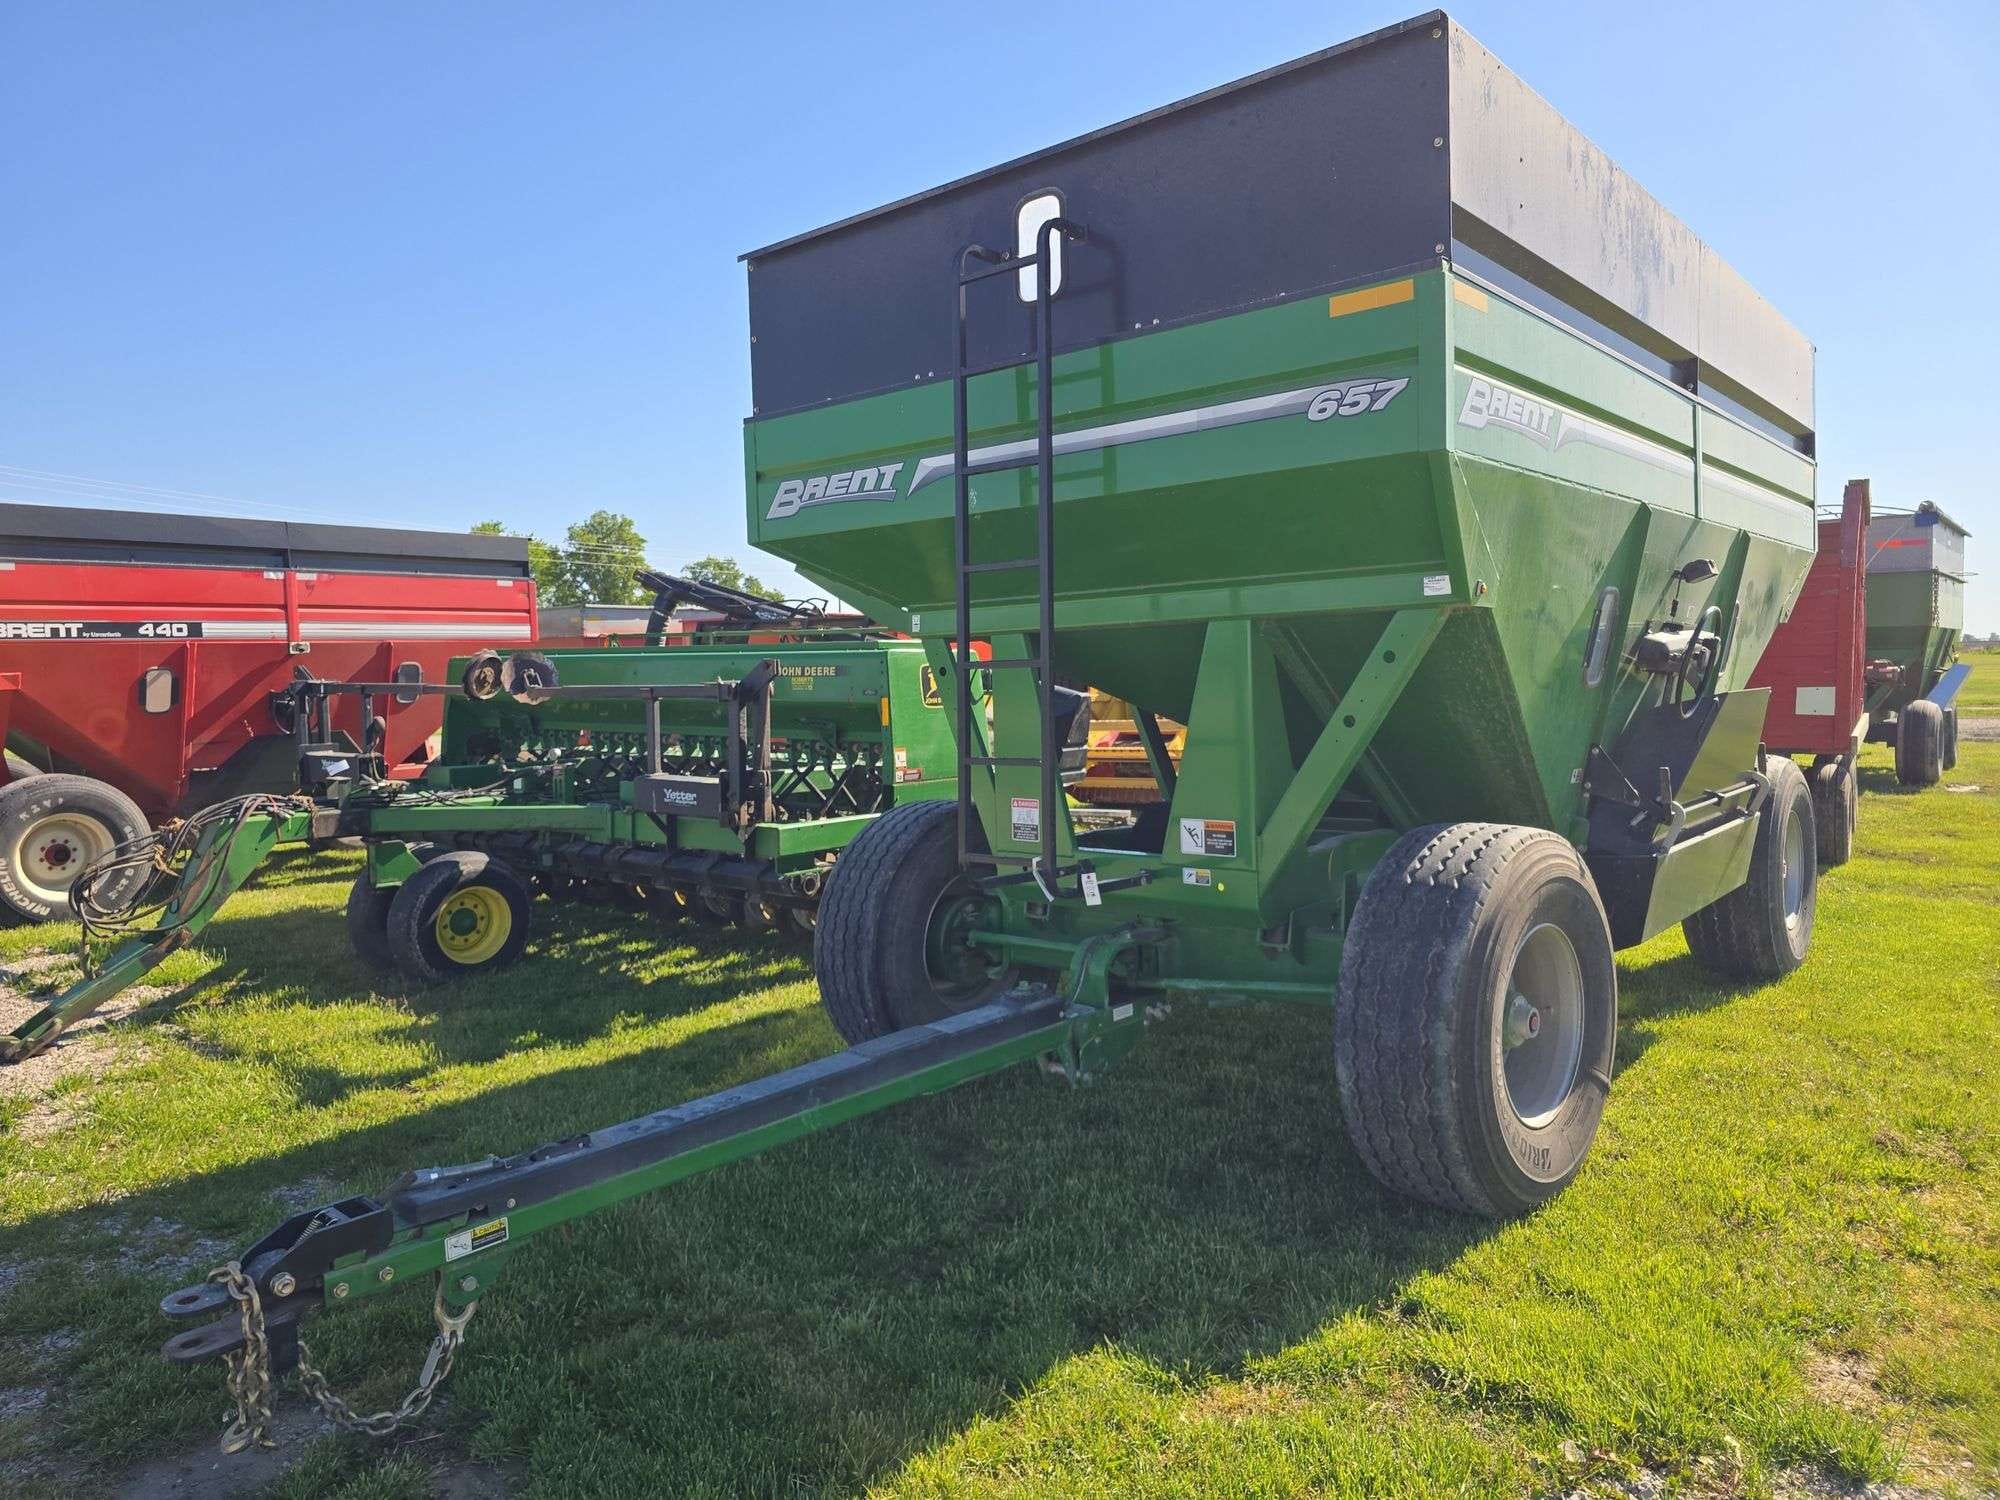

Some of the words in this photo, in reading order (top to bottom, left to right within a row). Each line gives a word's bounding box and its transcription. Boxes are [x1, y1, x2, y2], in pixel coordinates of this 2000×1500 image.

[1307, 377, 1411, 422] 657
[1457, 377, 1556, 433] BRENT
[765, 463, 904, 520] BRENT
[138, 623, 188, 637] 440
[804, 666, 836, 676] DEERE
[664, 788, 697, 801] Yetter
